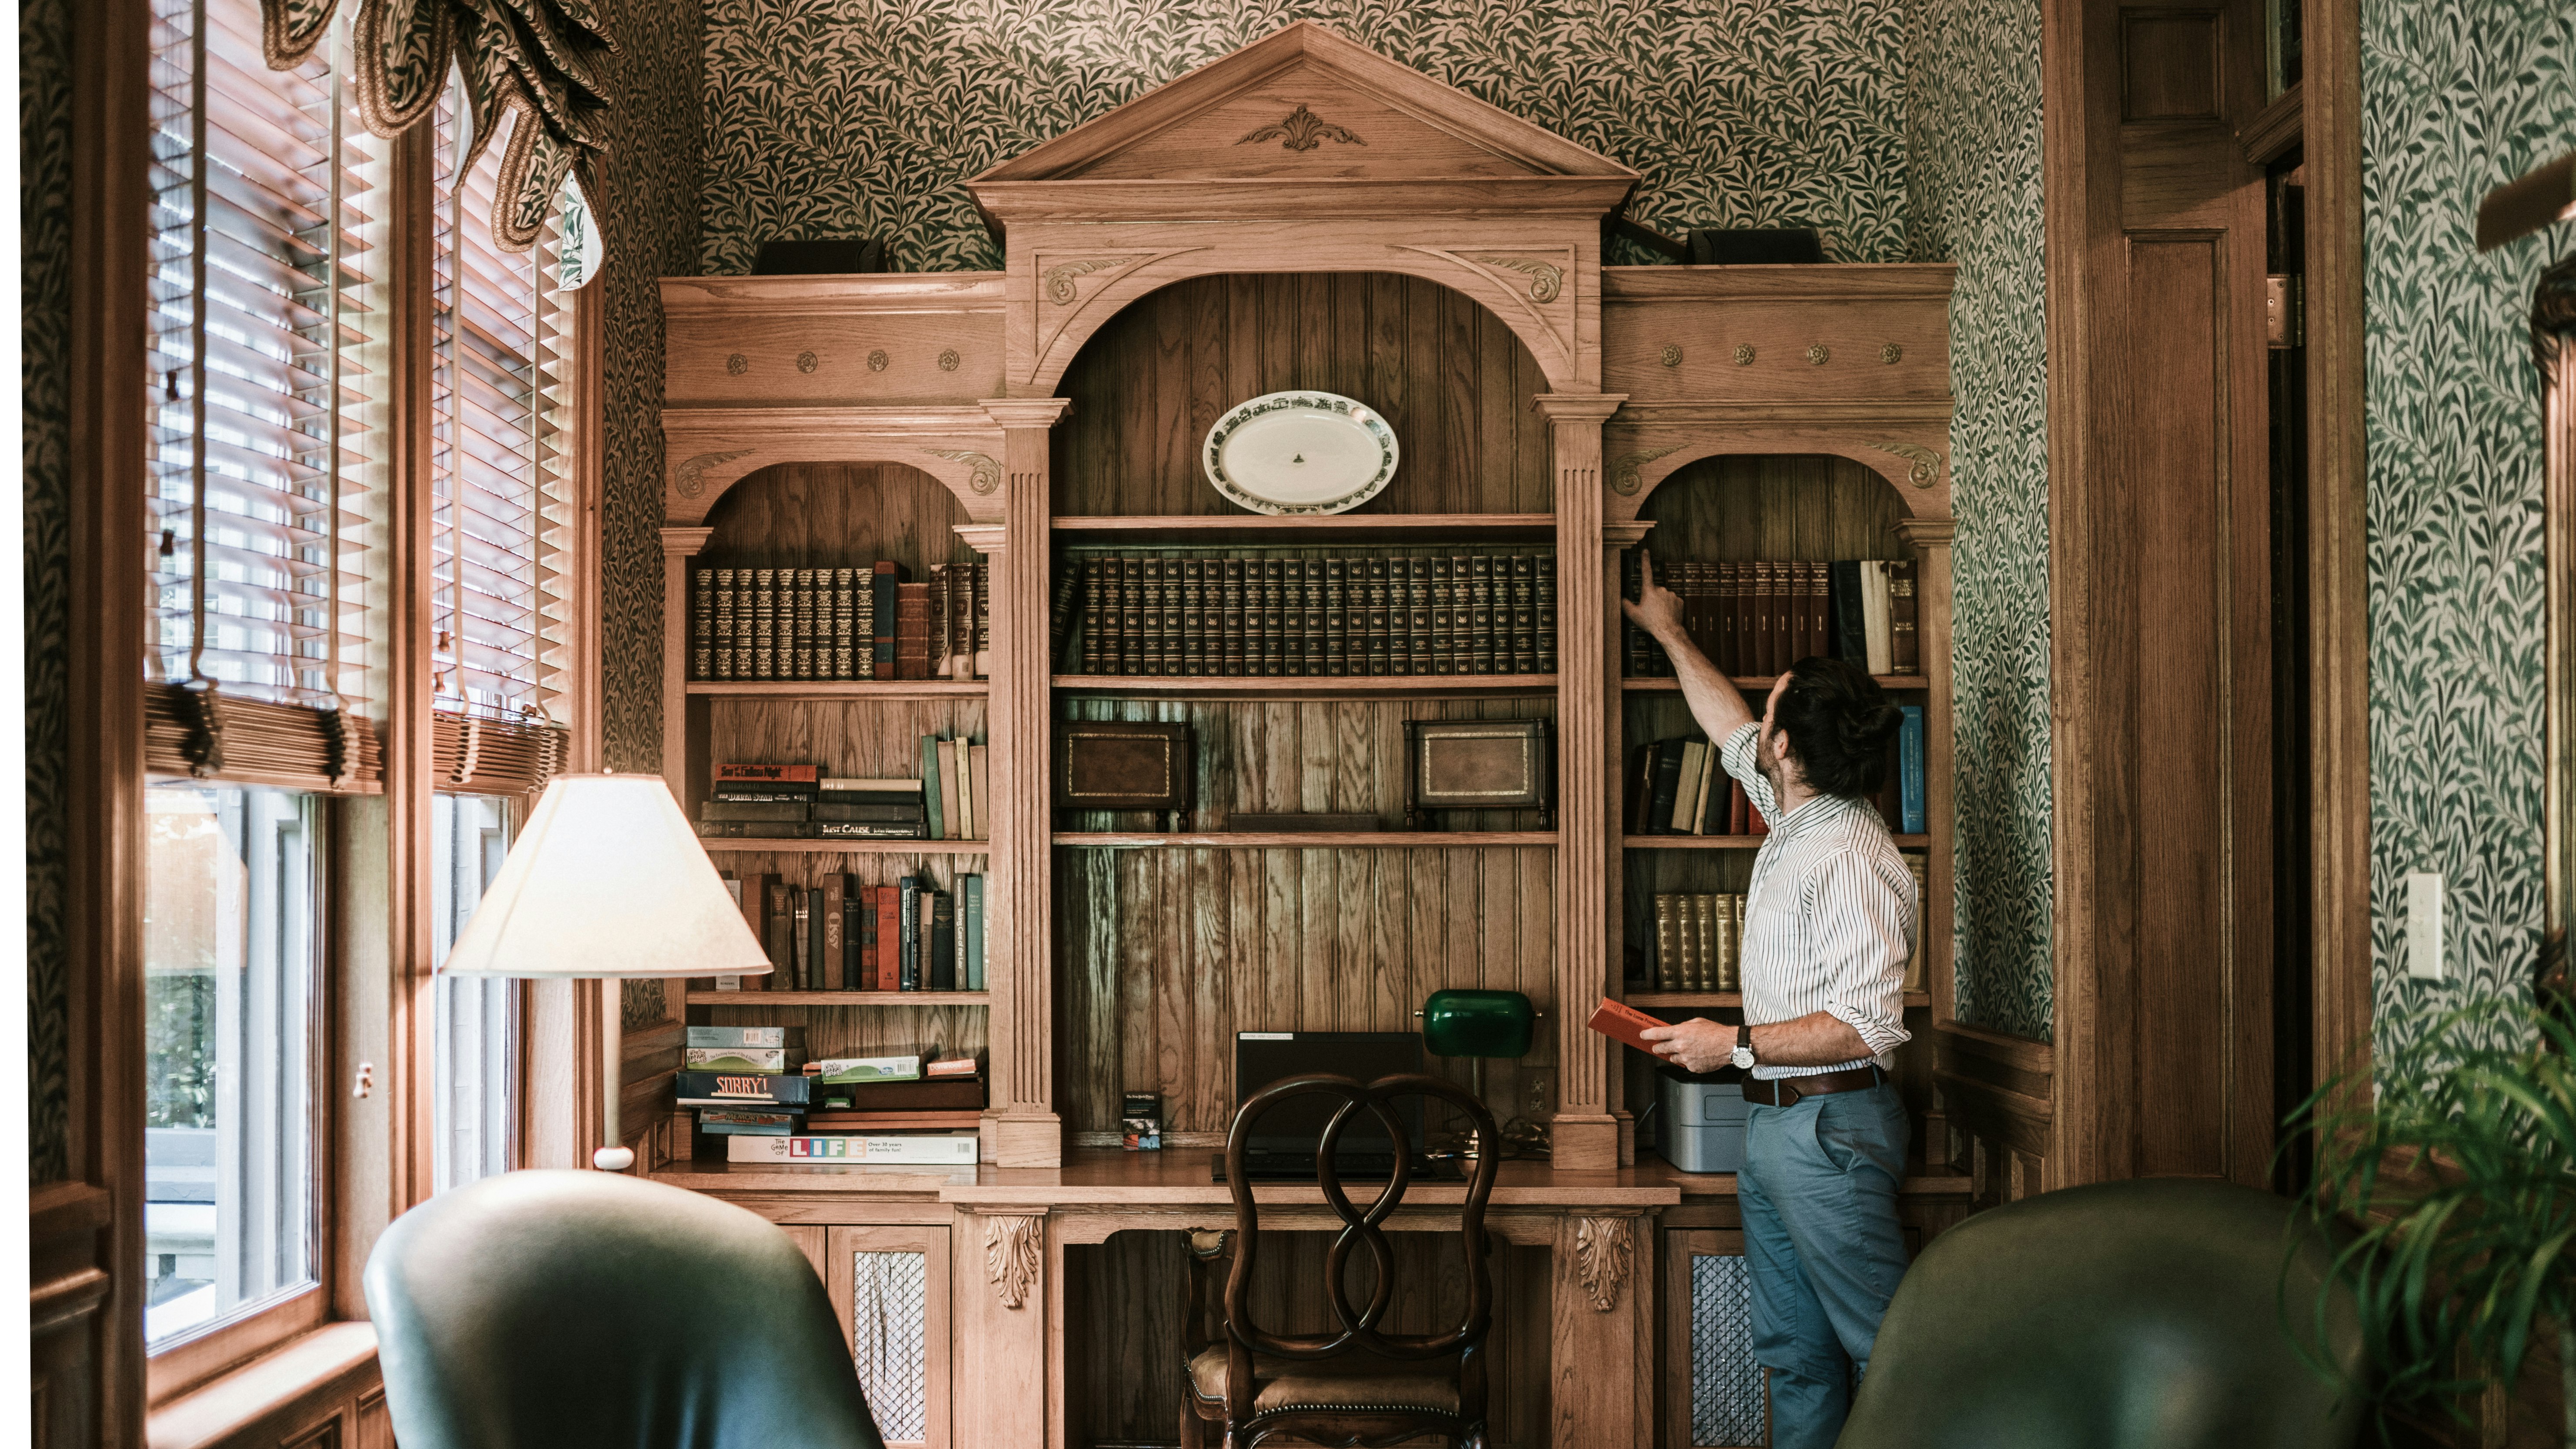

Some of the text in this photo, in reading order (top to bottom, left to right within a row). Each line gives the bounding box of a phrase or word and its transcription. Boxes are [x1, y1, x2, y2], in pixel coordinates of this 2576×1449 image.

[842, 825, 870, 833] CAUSE
[717, 1077, 768, 1094] SORRY!
[726, 1113, 759, 1121] MEMORY
[793, 1140, 863, 1156] LIFE
